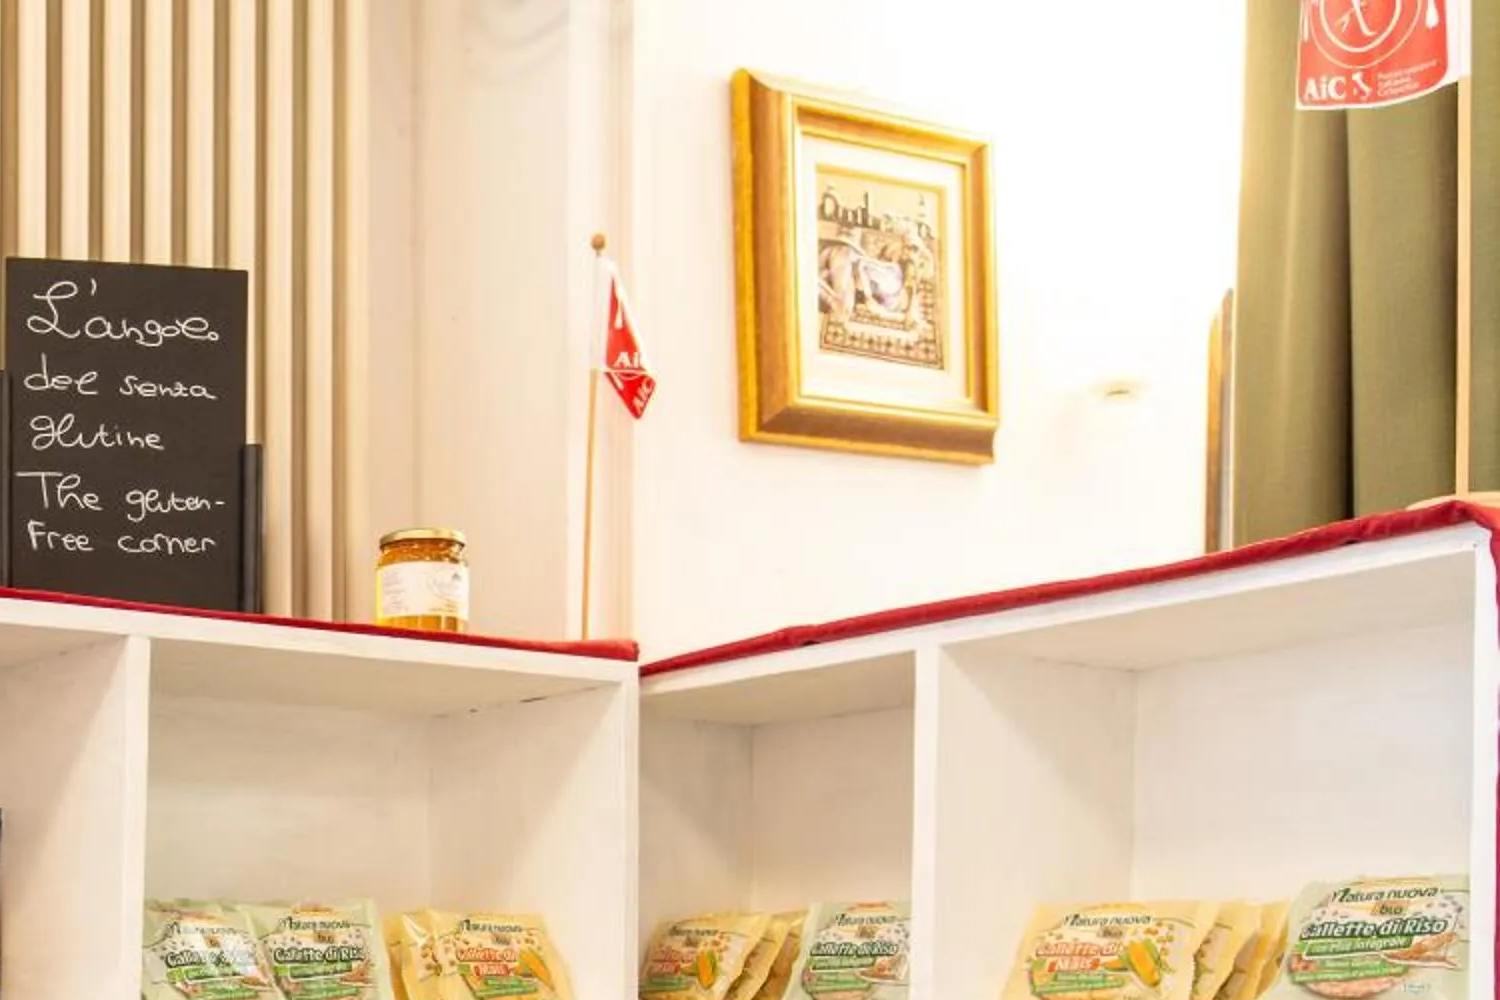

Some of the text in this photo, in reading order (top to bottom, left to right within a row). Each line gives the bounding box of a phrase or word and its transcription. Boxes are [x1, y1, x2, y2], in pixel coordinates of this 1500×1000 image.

[24, 353, 99, 396] del
[29, 413, 165, 451] glutine
[15, 471, 103, 511] The
[27, 520, 215, 555] Free corner
